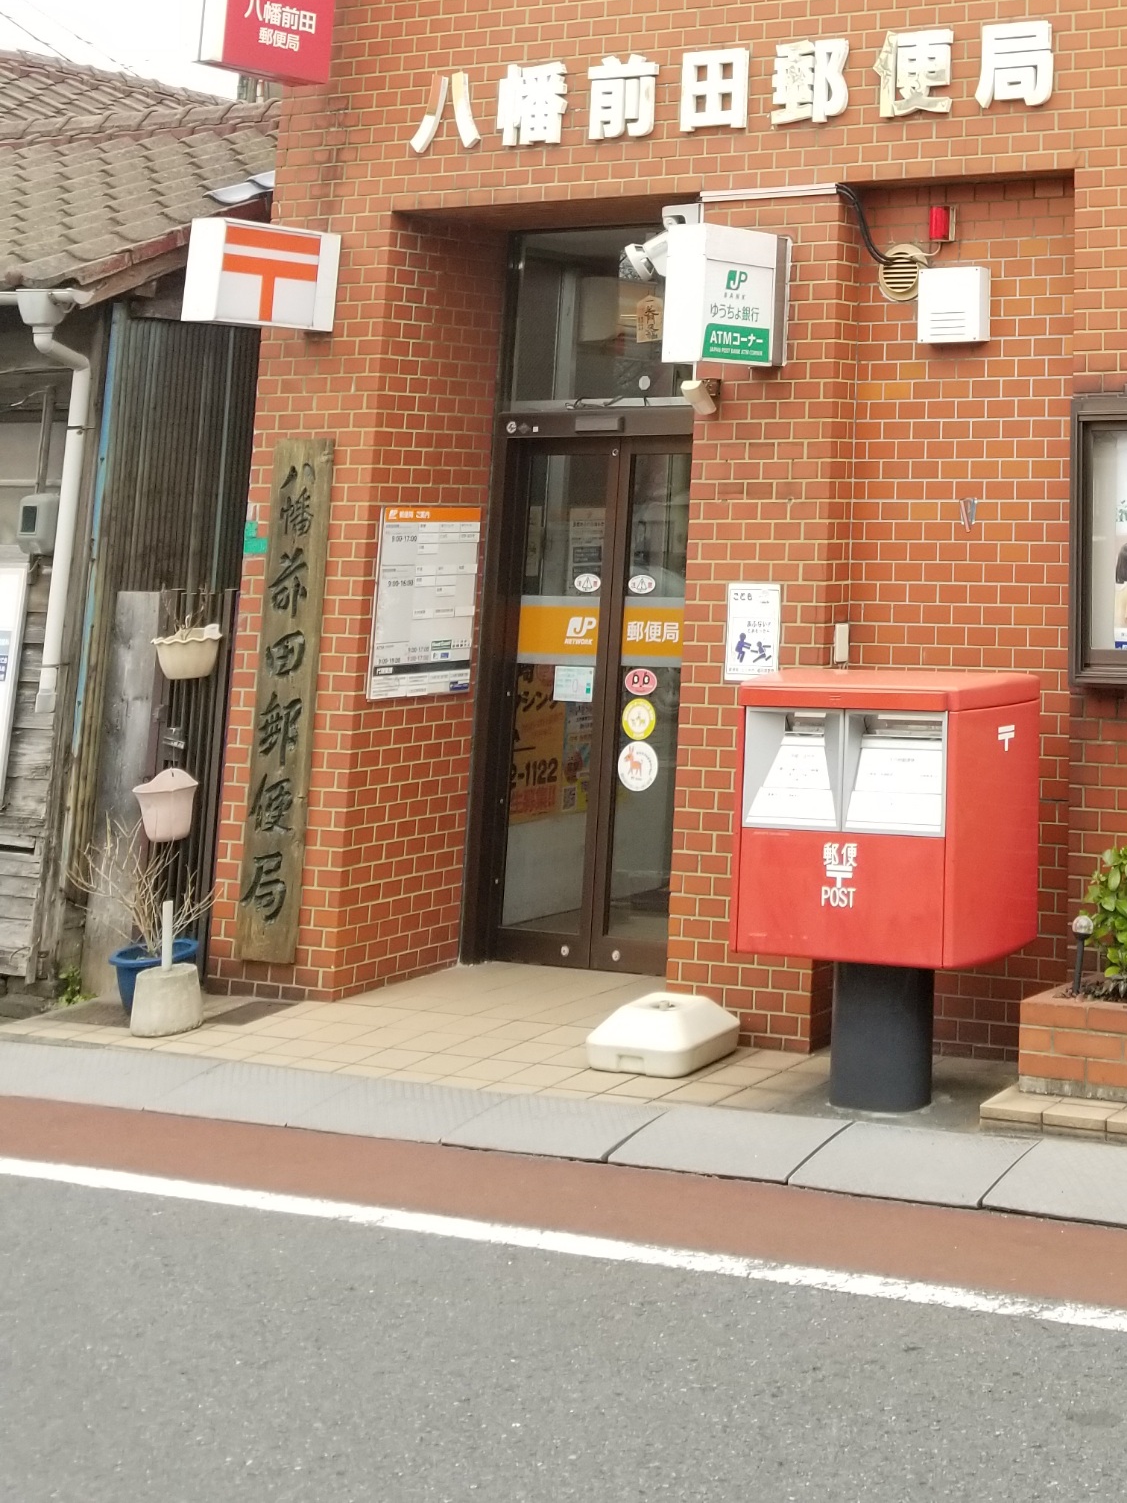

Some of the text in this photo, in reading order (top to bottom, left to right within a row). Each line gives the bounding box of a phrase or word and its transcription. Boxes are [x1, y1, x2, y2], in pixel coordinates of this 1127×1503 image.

[258, 27, 299, 51] 郵便局
[410, 20, 1052, 153] 八幡前田郵便局
[724, 292, 746, 300] BANK
[710, 303, 760, 322] ゆうちょ銀行
[710, 330, 763, 347] ATMコーナー
[733, 592, 753, 601] こども
[627, 621, 679, 643] 郵便局
[242, 463, 315, 923] 八幡前田郵便局
[823, 843, 858, 867] 郵便
[821, 886, 857, 909] POST
